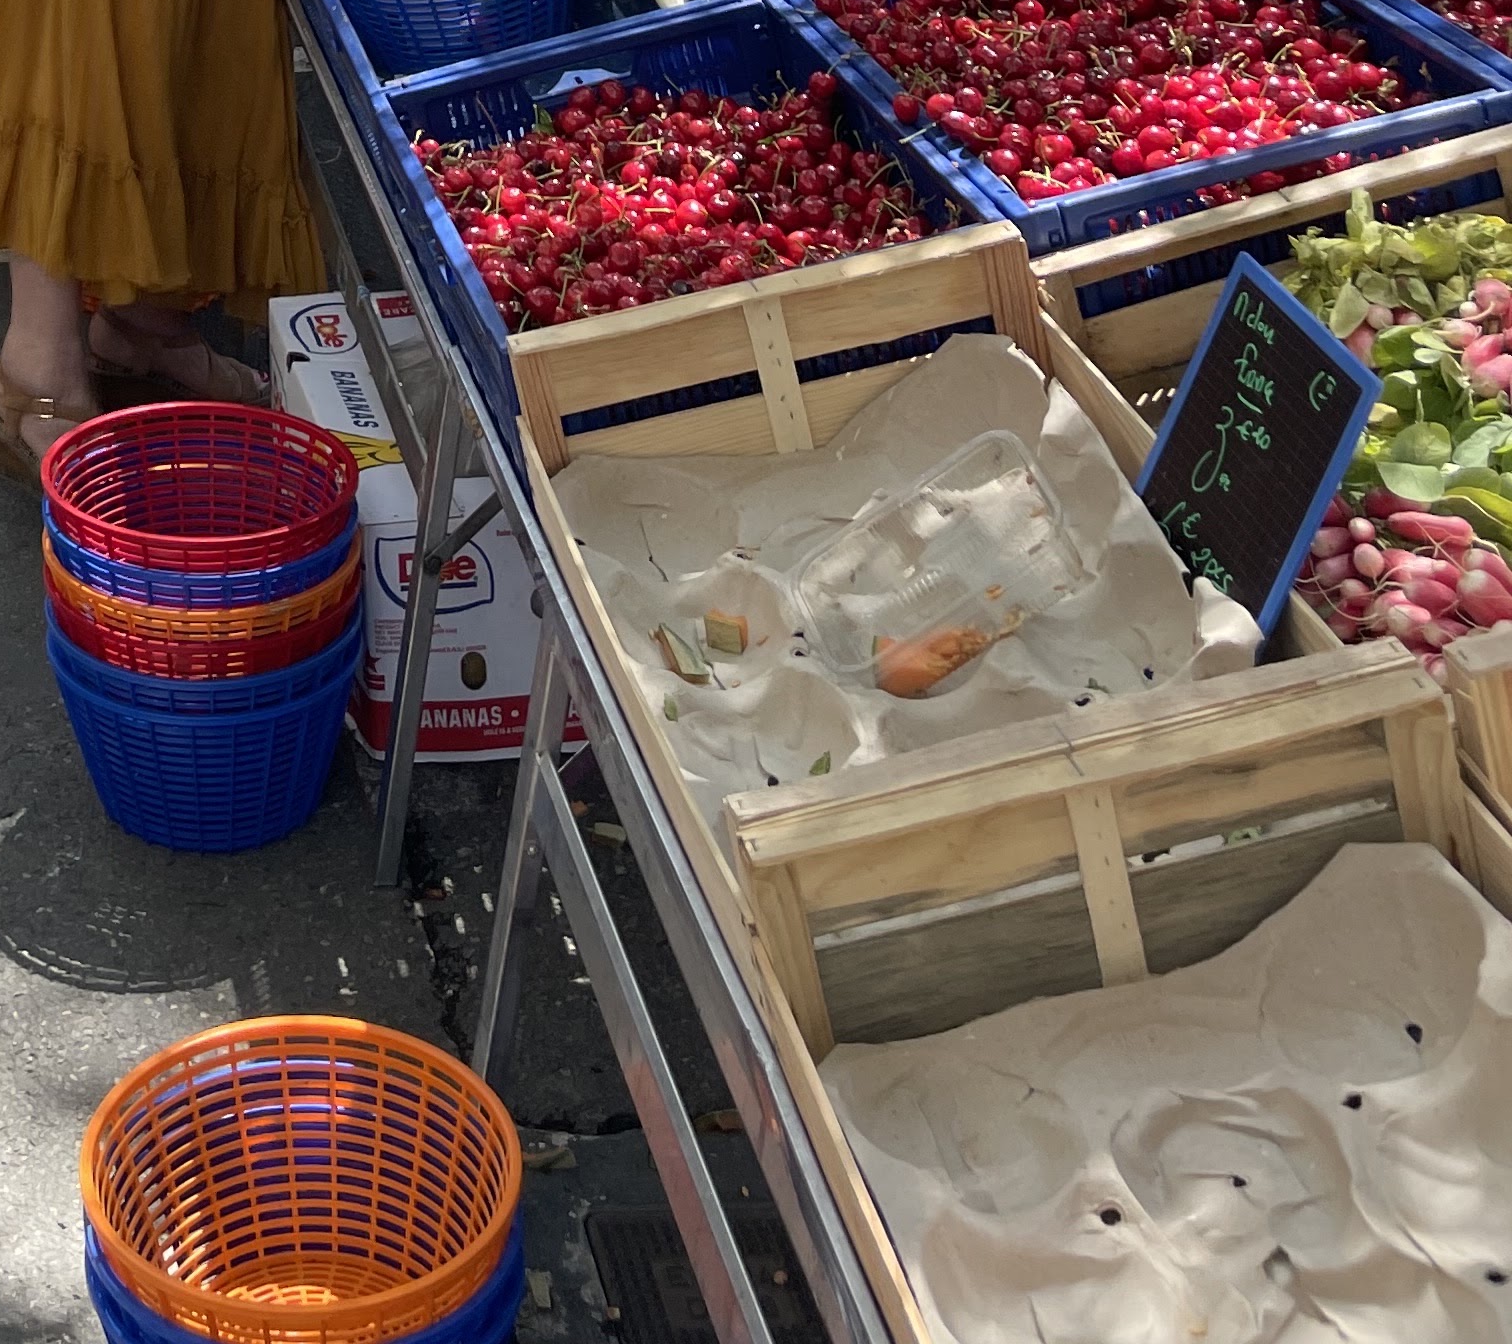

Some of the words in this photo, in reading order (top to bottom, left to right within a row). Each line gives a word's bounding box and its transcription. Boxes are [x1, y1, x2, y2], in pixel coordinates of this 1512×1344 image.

[316, 314, 348, 349] Dole
[330, 370, 379, 429] BANANAS
[420, 705, 503, 729] ANANAS
